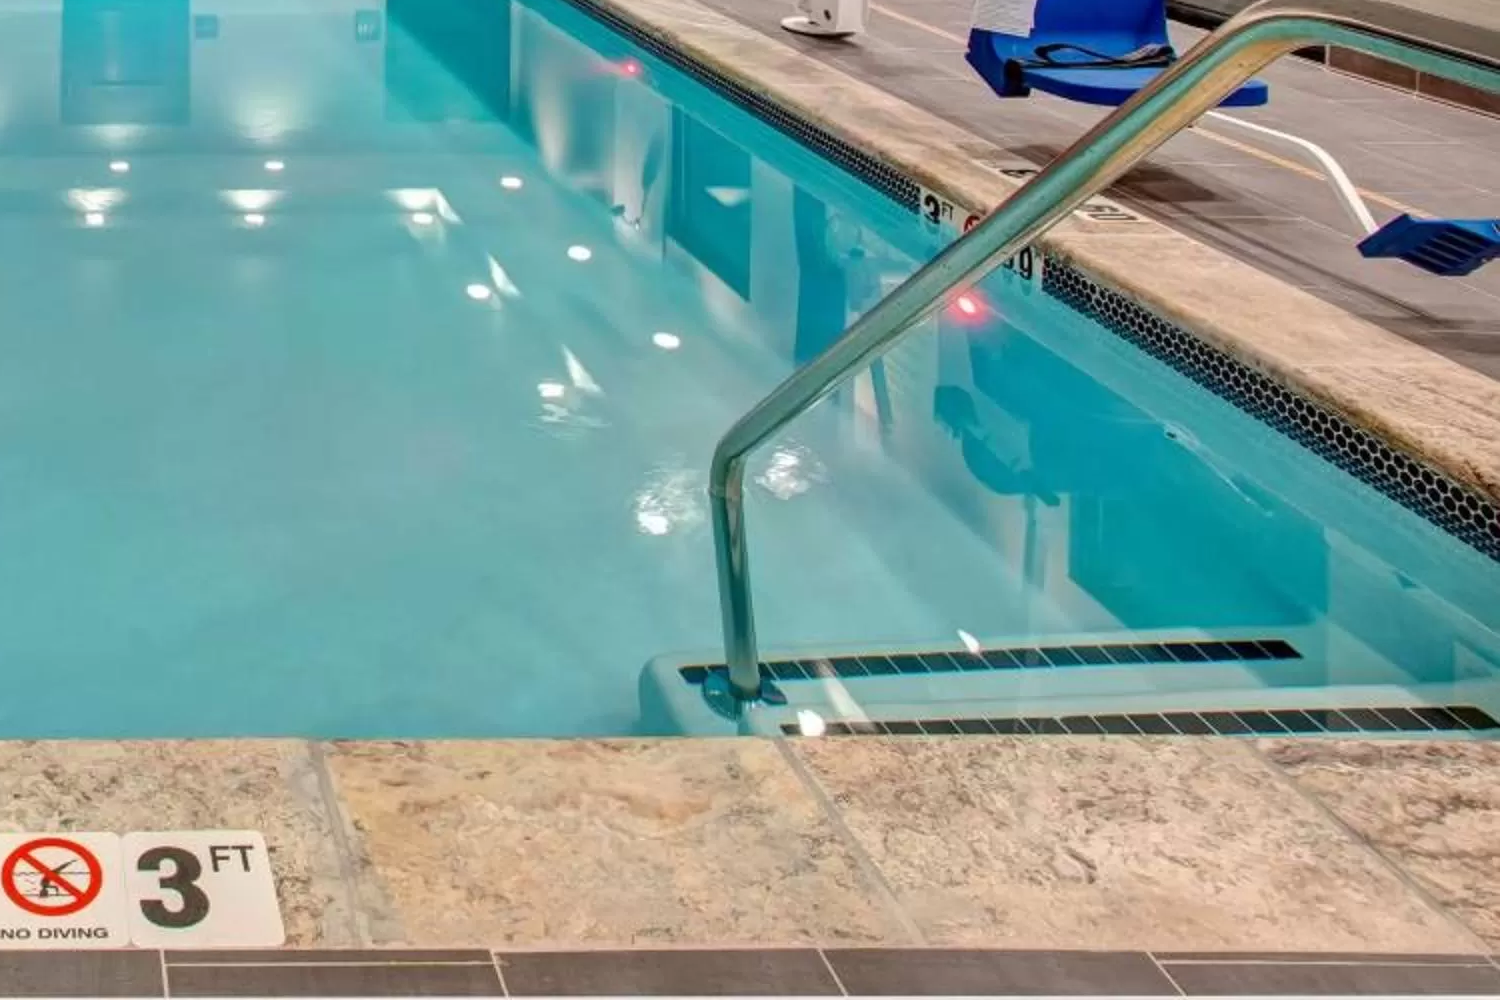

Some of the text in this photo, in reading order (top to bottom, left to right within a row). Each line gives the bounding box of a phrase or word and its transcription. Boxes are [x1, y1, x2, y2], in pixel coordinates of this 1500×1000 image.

[137, 844, 254, 929] 3 FT
[0, 926, 109, 940] NO DIVING
